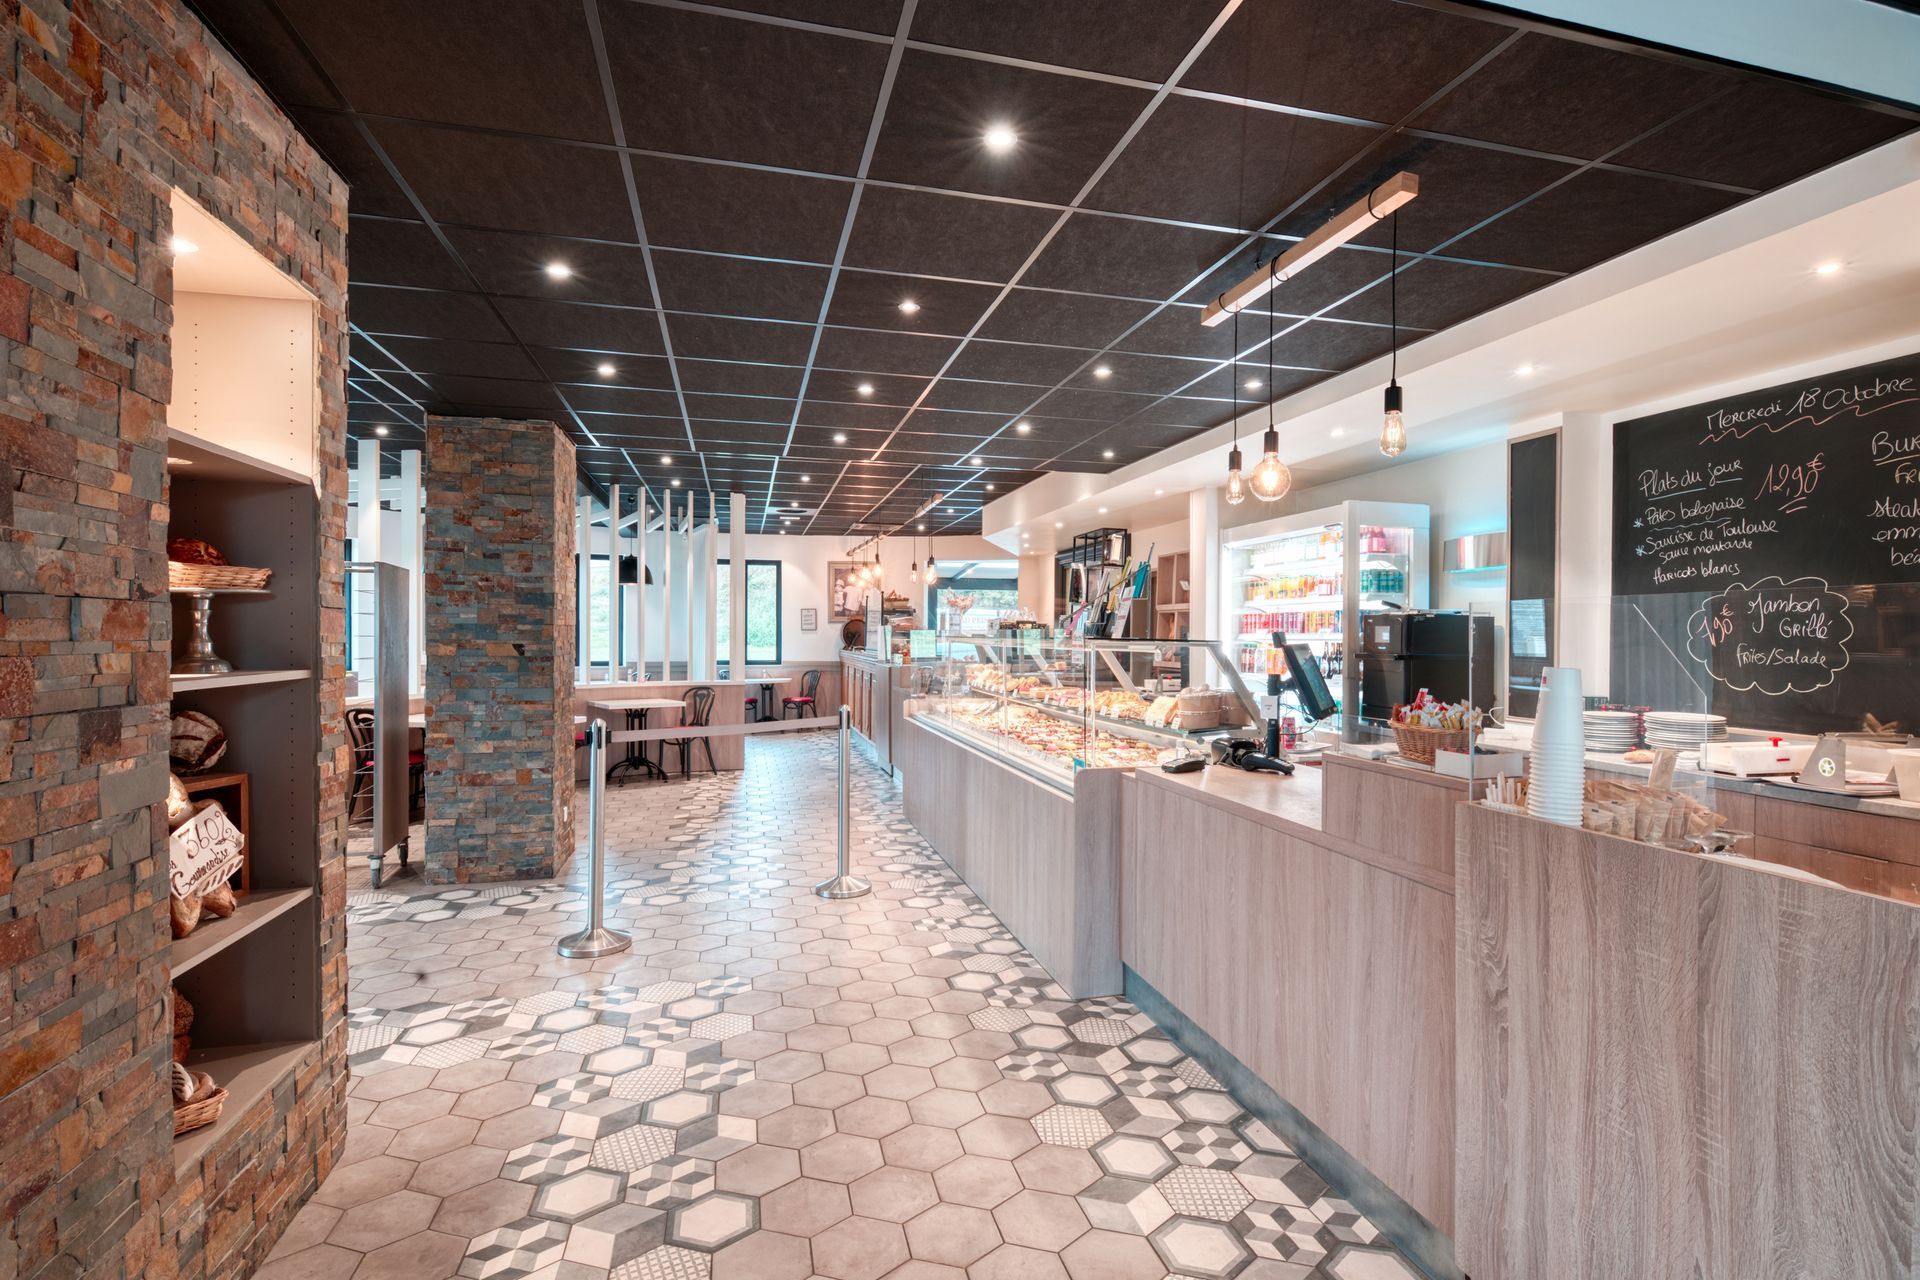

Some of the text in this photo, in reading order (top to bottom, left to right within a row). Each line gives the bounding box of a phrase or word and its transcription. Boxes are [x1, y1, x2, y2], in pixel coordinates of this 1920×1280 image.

[1784, 387, 1821, 416] 18
[1638, 459, 1743, 497] Plats du jour
[1645, 518, 1779, 555] Saucisse de Toulouse
[1693, 538, 1753, 556] moutarde
[1700, 559, 1741, 578] blancs
[1747, 592, 1820, 634] Jambon
